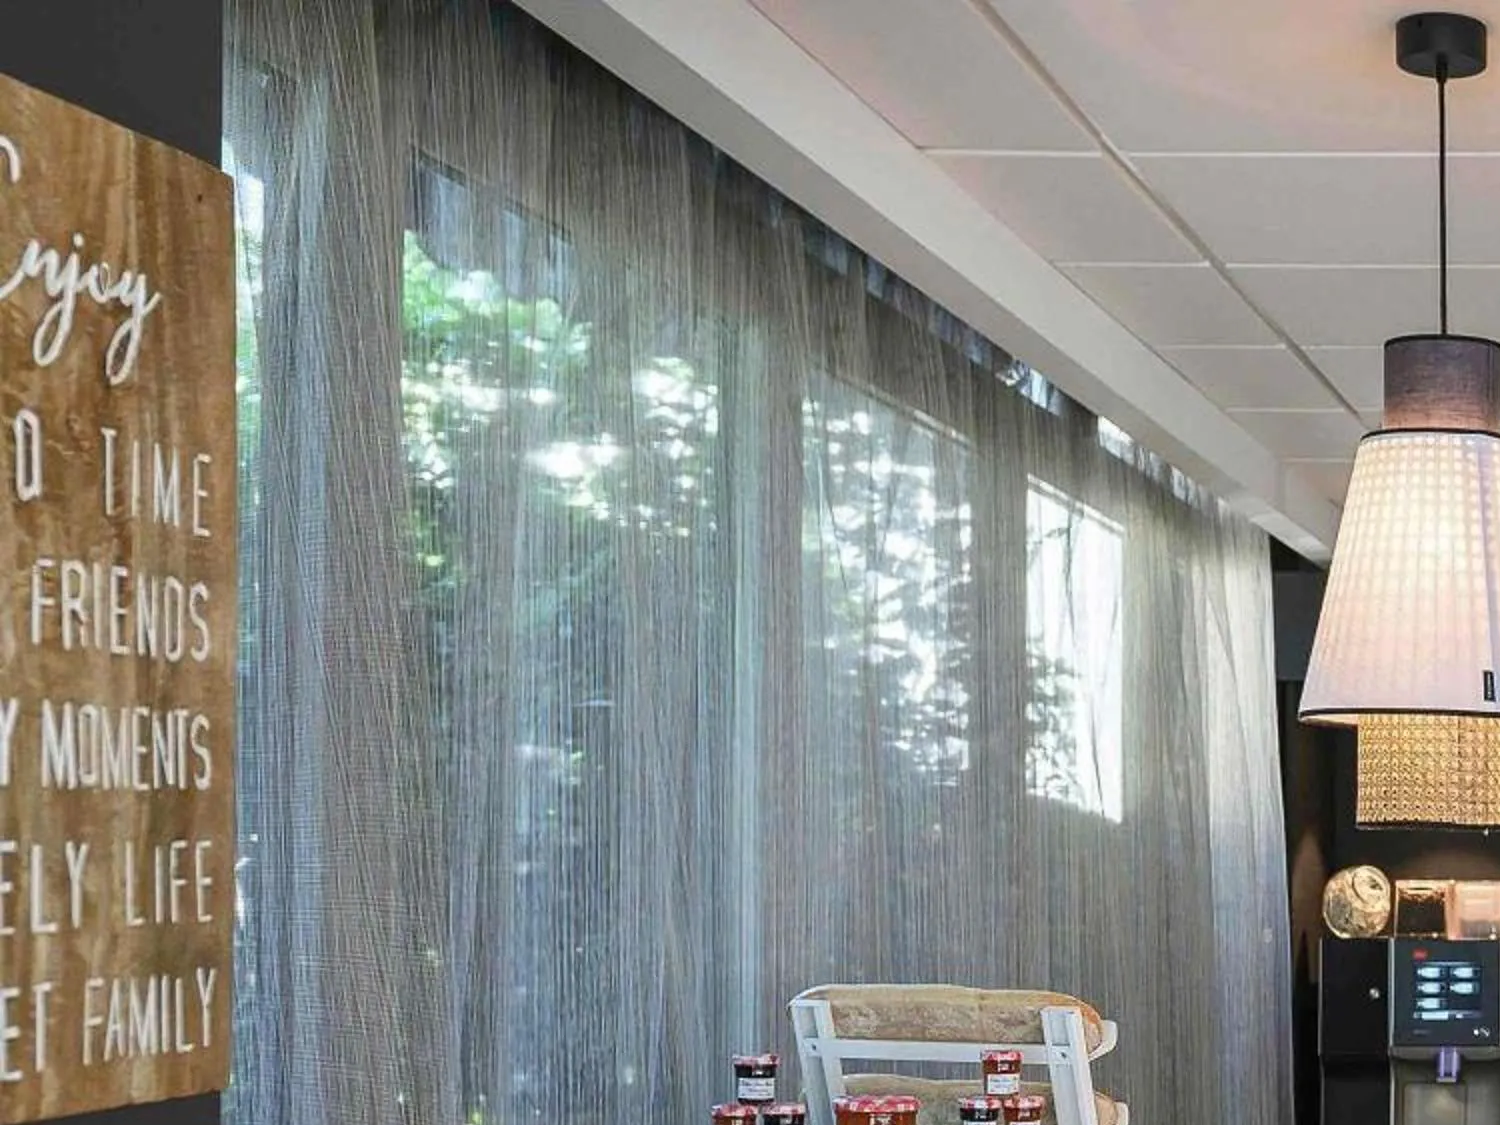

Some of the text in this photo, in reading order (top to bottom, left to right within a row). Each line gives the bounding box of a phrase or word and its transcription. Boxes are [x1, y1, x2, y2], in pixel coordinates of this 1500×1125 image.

[0, 232, 163, 387] njoy
[100, 426, 213, 538] TIME
[30, 557, 210, 663] FRIENDS
[41, 698, 212, 792] MOMENTS
[125, 839, 214, 927] LIFE
[82, 966, 217, 1067] FAMILY
